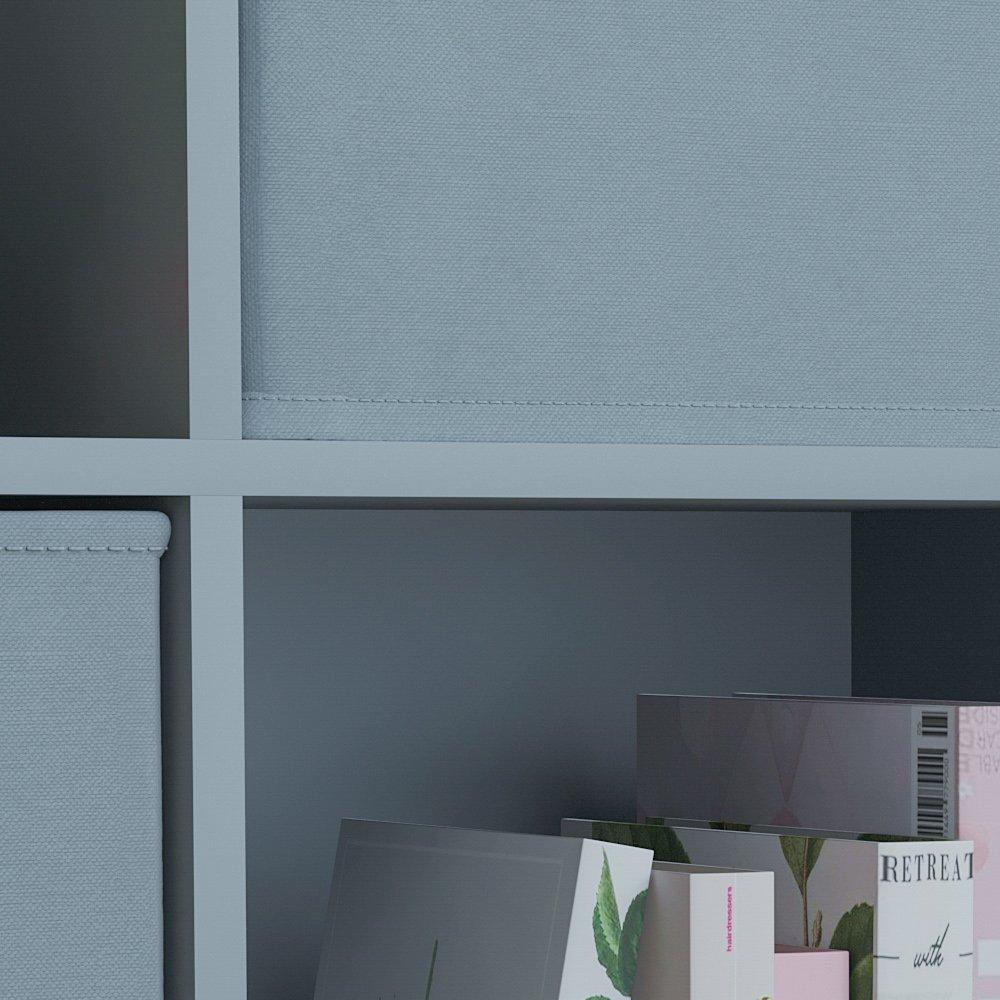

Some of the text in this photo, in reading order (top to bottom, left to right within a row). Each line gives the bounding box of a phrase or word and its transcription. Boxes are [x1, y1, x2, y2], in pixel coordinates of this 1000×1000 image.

[880, 852, 974, 883] RETREAT
[725, 884, 734, 953] hairdressers
[913, 922, 950, 969] with
